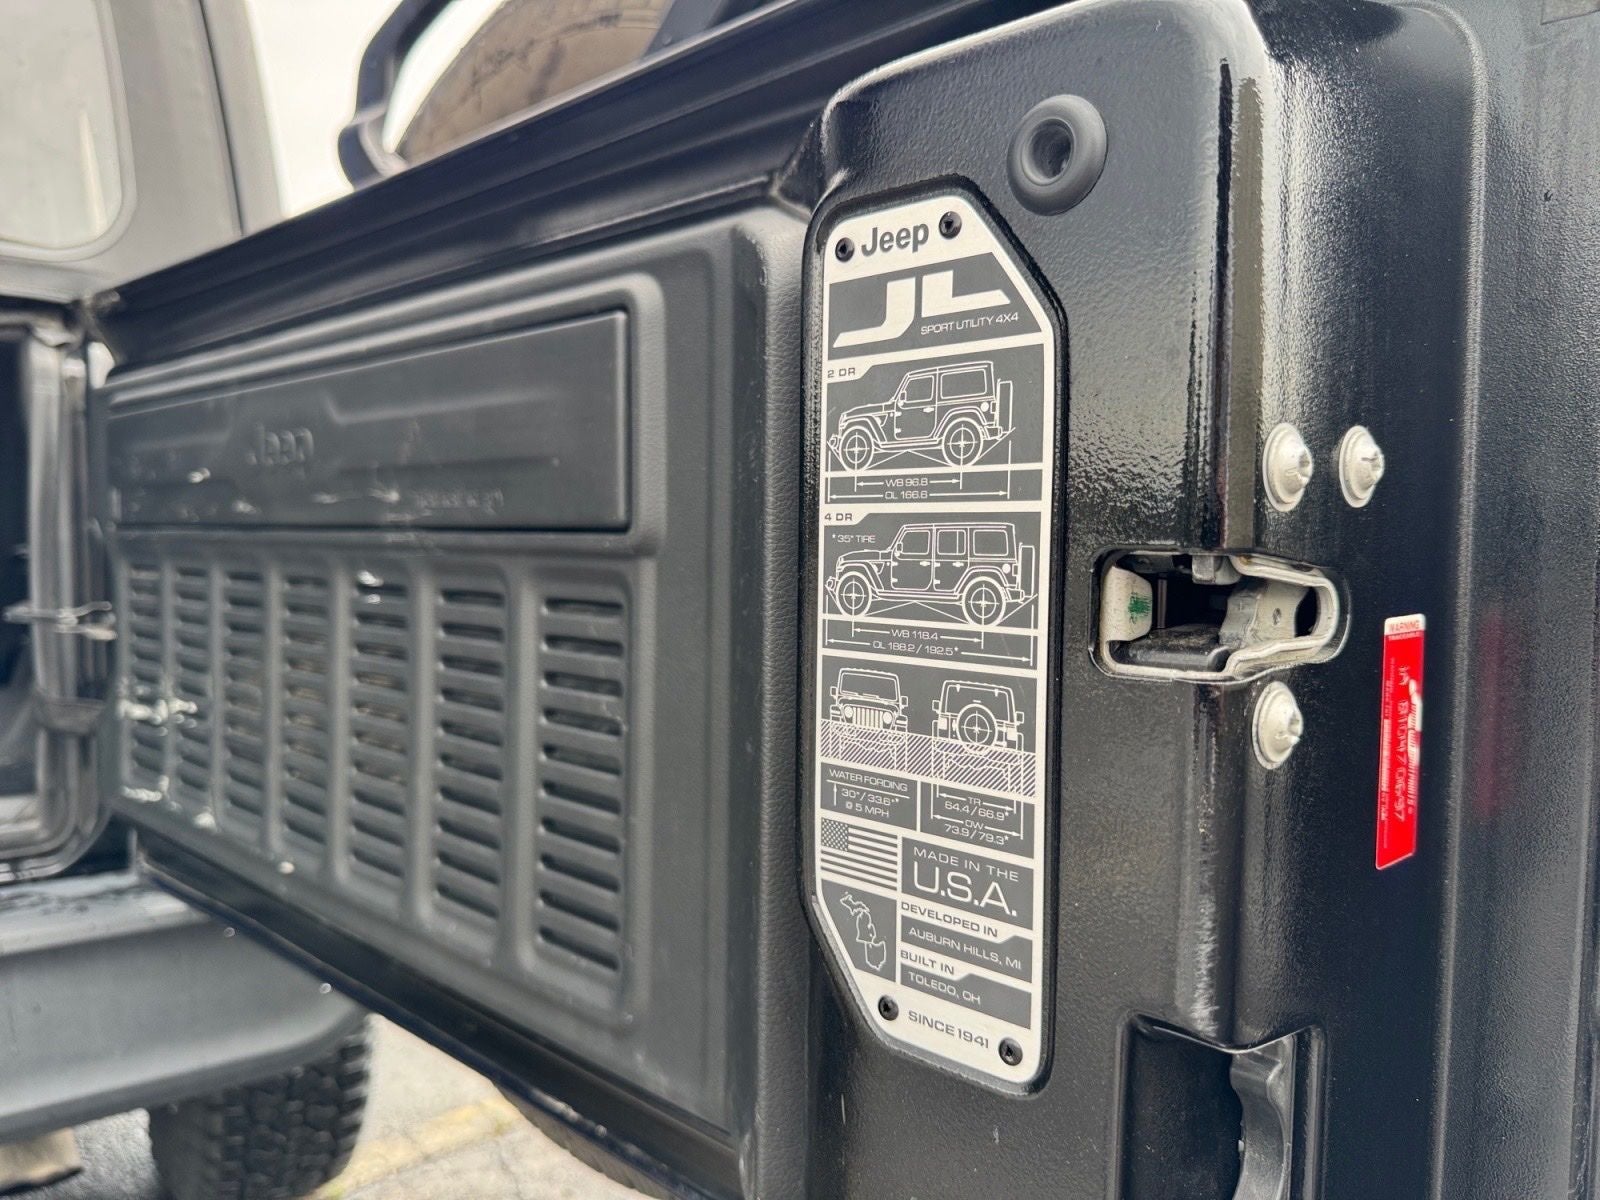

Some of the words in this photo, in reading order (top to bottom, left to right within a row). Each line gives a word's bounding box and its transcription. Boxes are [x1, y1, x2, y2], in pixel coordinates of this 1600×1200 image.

[861, 223, 929, 256] Jeep
[832, 270, 1011, 348] JL
[921, 321, 955, 335] SPORT
[956, 316, 994, 330] UTILITY
[996, 312, 1019, 323] 4X4
[827, 369, 835, 378] 2
[839, 367, 856, 377] DR
[885, 478, 904, 487] WB
[905, 477, 928, 487] 96.8
[885, 491, 898, 500] OL
[824, 512, 832, 521] 4
[835, 512, 853, 521] DR
[855, 534, 876, 544] TIRE
[872, 640, 887, 650] OL
[891, 629, 910, 638] WB
[912, 630, 938, 640] 118.4
[829, 768, 863, 783] WATER
[863, 775, 908, 792] FORDING
[855, 803, 863, 812] 5
[864, 805, 890, 818] MPH
[968, 796, 982, 806] TR
[965, 819, 984, 830] OW
[913, 846, 959, 867] MADE
[964, 859, 980, 872] IN
[986, 865, 1019, 882] THE
[913, 861, 1018, 917] U.S.A.
[901, 901, 980, 932] DEVELOPED
[983, 925, 998, 938] IN
[909, 927, 960, 951] AUBURN
[963, 943, 1002, 965] HILLS,
[1005, 956, 1022, 970] MI
[900, 949, 937, 969] BUILT
[940, 963, 955, 975] IN
[908, 971, 960, 999] TOLEDO,
[962, 990, 981, 1004] OH
[908, 1010, 955, 1037] SINCE
[958, 1028, 989, 1049] 1941
